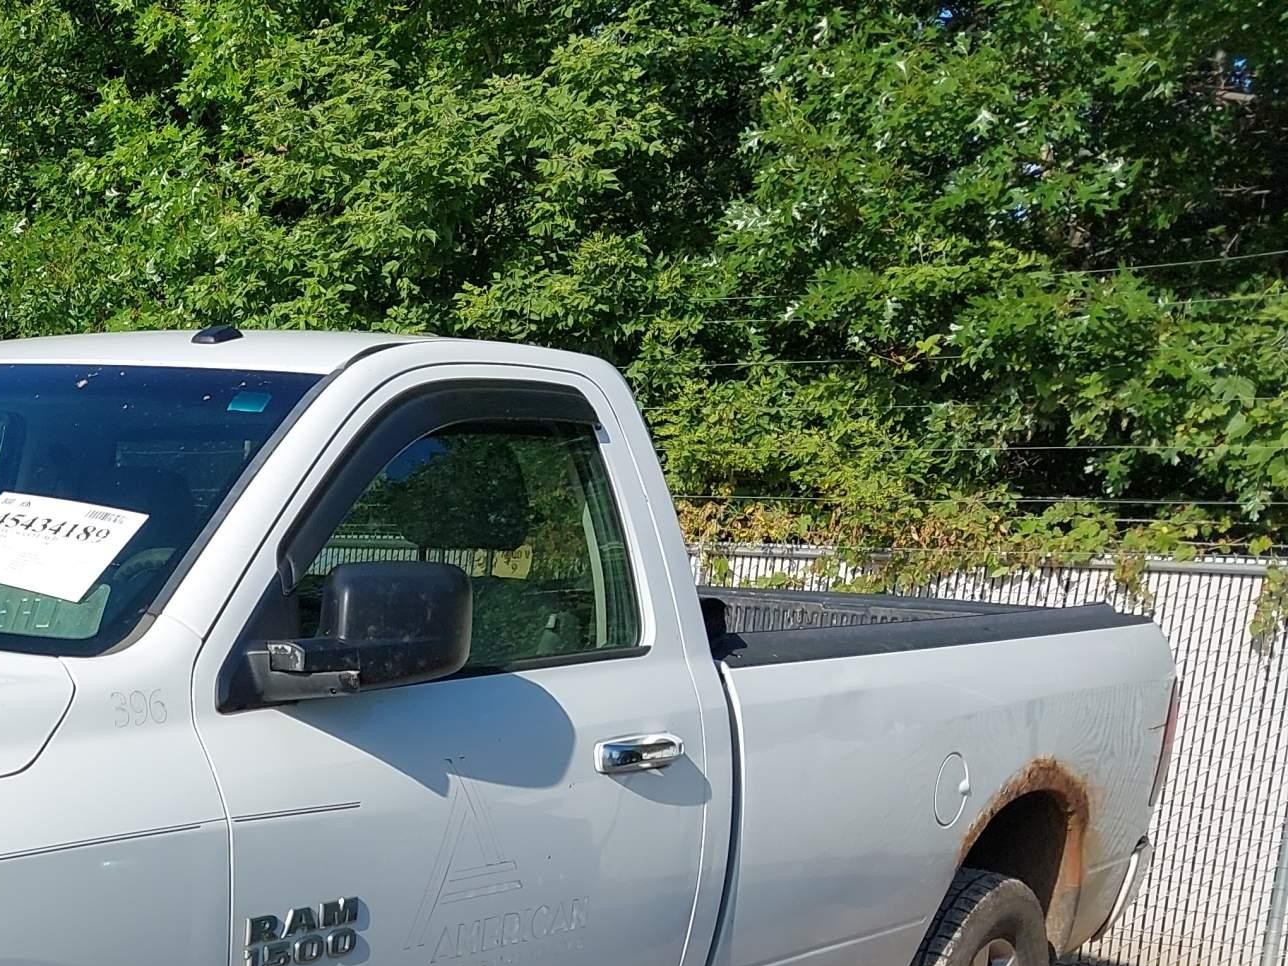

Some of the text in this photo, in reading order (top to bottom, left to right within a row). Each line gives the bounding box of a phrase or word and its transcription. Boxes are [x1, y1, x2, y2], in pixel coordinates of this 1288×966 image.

[110, 688, 168, 729] 396
[244, 896, 359, 946] RAM
[429, 896, 590, 964] AMERICAN
